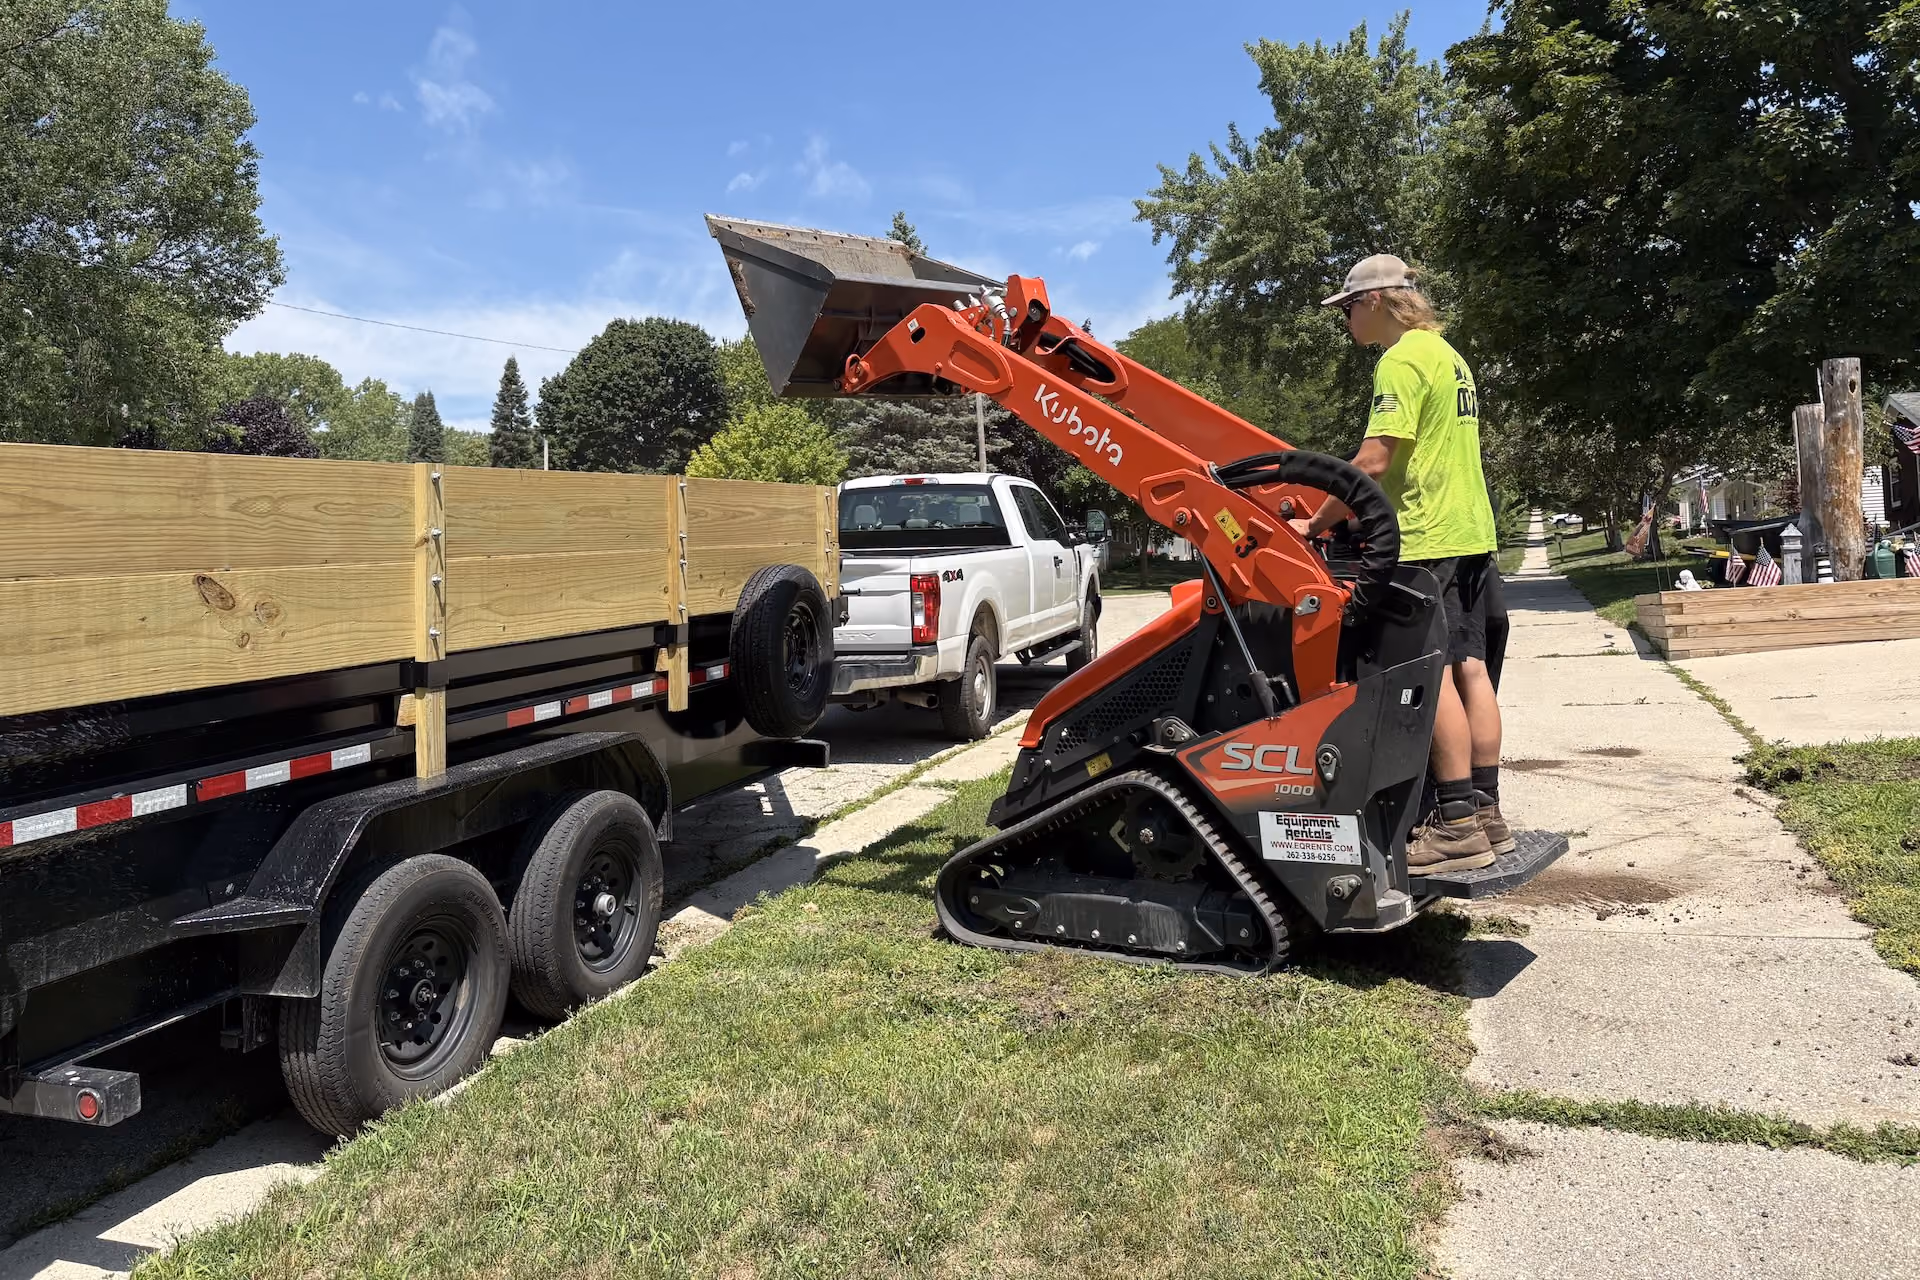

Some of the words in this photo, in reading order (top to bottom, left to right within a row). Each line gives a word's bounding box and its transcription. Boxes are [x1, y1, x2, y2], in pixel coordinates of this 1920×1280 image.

[1034, 383, 1123, 466] Kubota
[1220, 743, 1313, 775] SCL
[1274, 783, 1314, 796] 1000
[1276, 815, 1340, 829] Equipment
[1285, 828, 1333, 840] Rentals
[1271, 840, 1354, 852] WWW.EQRENTS.COM
[1286, 850, 1336, 861] 262-338-6256
